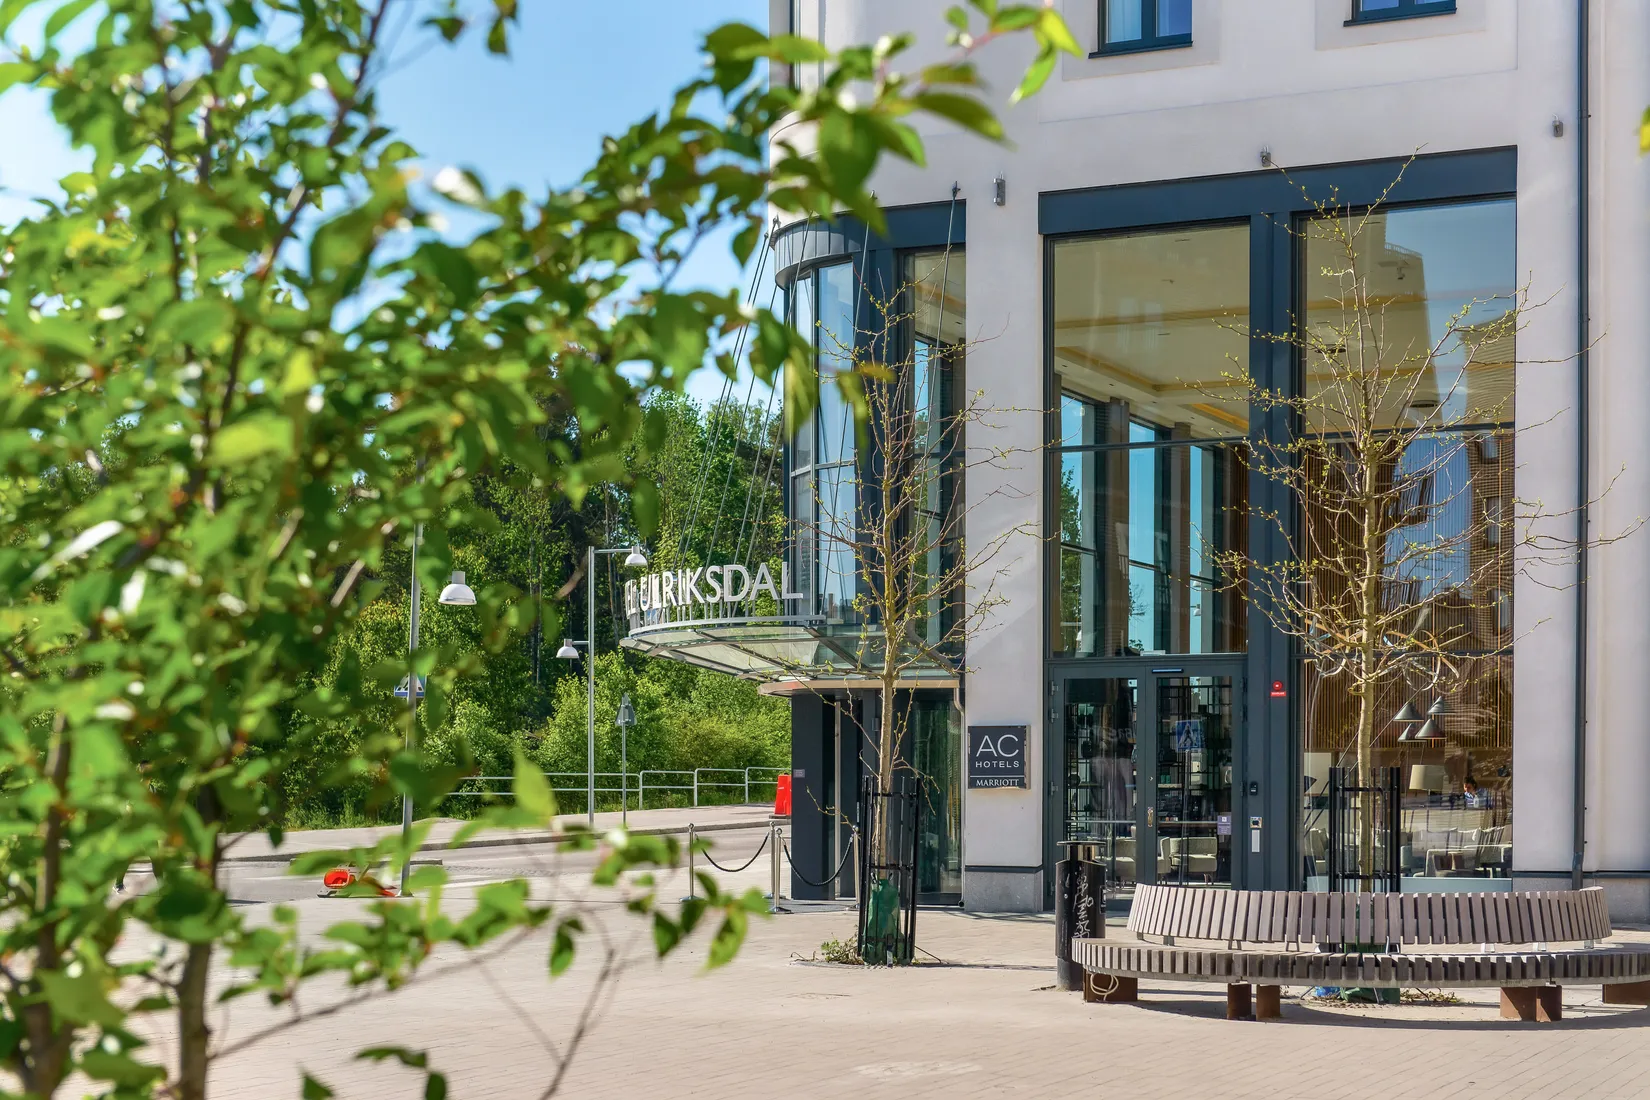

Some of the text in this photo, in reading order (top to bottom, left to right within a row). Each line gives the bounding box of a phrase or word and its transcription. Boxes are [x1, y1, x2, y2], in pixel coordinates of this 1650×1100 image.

[640, 562, 803, 612] ULRIKSDAL
[976, 734, 1019, 757] AC
[975, 760, 1020, 768] HOTELS
[976, 779, 1019, 787] MARRIOTT
